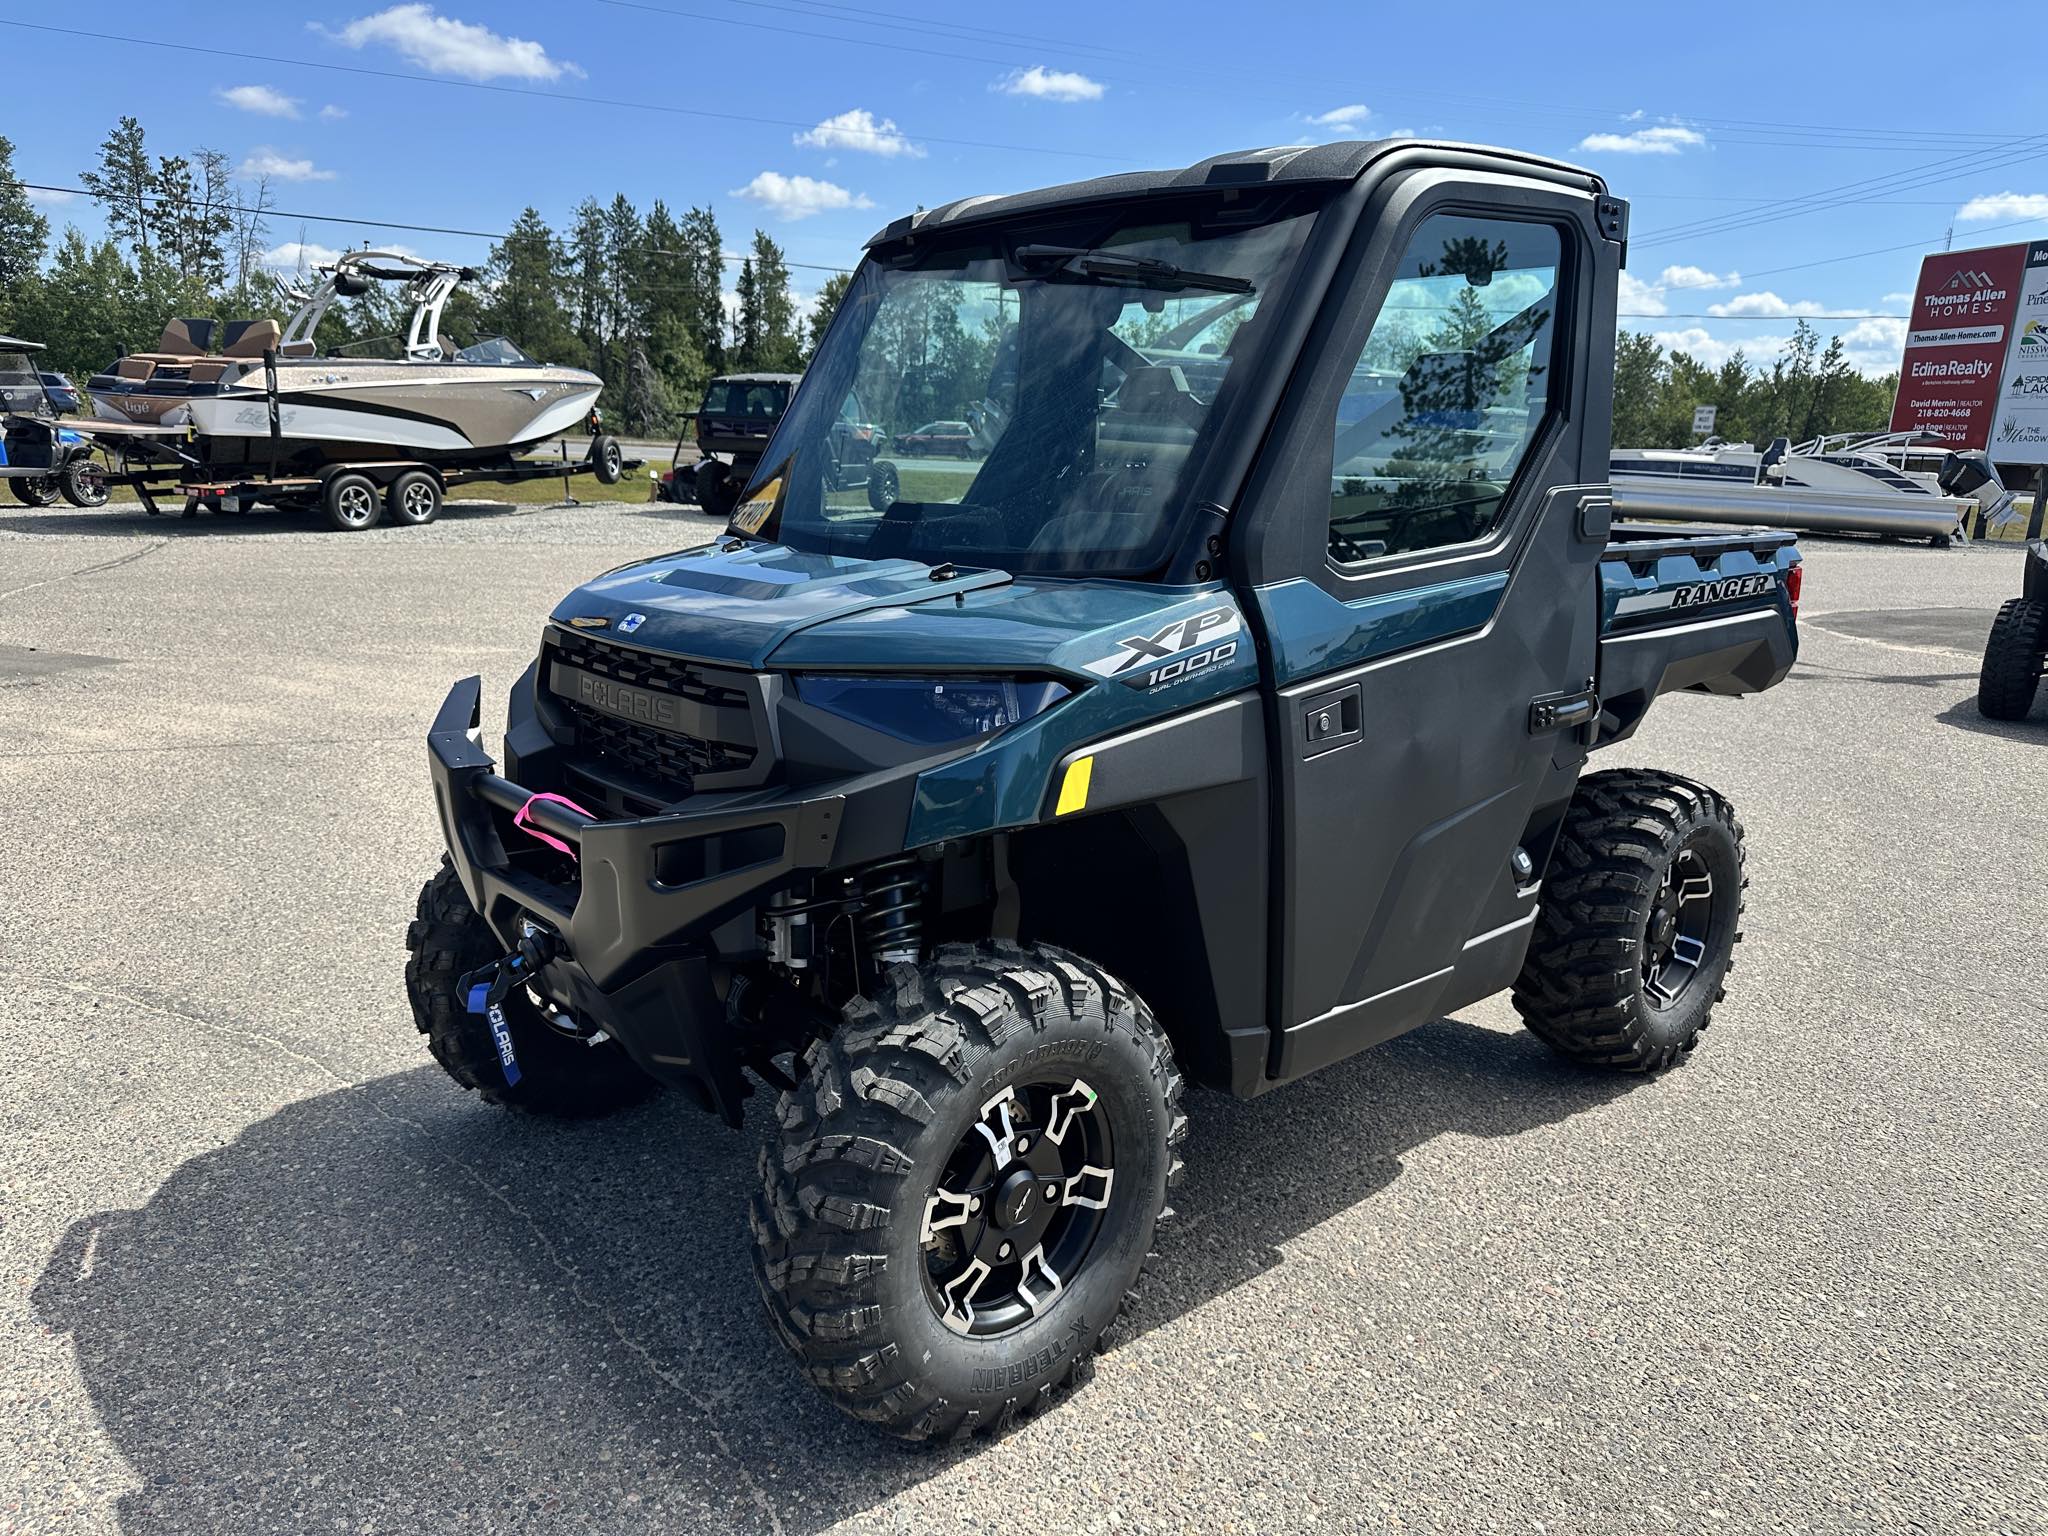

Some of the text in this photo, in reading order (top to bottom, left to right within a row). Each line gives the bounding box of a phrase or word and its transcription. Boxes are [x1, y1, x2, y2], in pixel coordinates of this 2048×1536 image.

[1924, 289, 2006, 306] Thomas Allen
[1930, 302, 1992, 317] HOMES
[1910, 400, 1930, 408] David
[1917, 408, 1971, 417] 218-820-4668
[1912, 423, 1925, 431] Joe
[1669, 574, 1770, 609] RANGER
[1111, 606, 1237, 675] XP
[1148, 641, 1237, 686] 1000
[1148, 659, 1235, 695] DUAL OVERHEAD CAM
[581, 675, 674, 724] POLARIS
[970, 1314, 1093, 1393] X-TERRAIN
